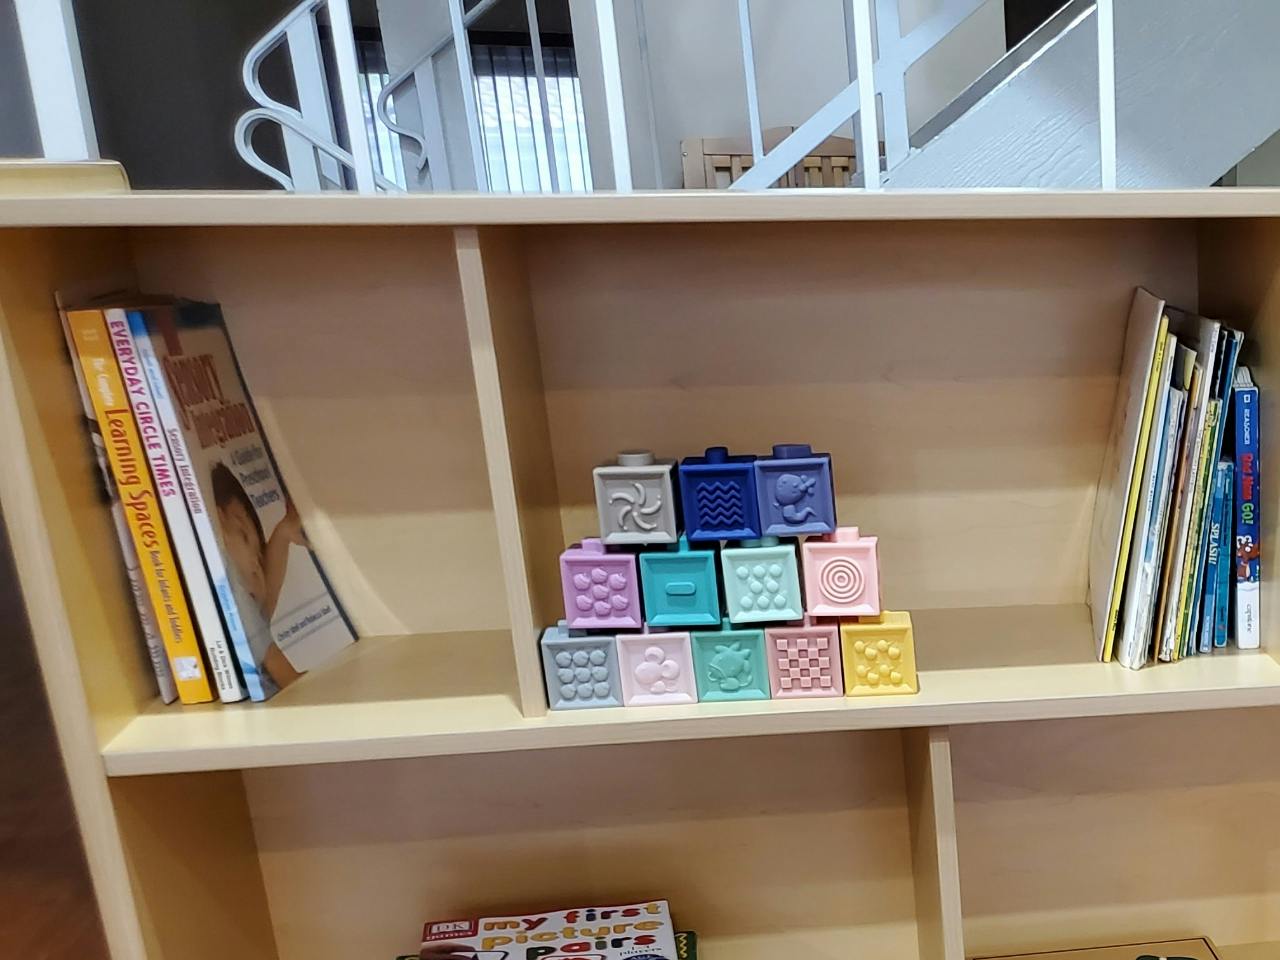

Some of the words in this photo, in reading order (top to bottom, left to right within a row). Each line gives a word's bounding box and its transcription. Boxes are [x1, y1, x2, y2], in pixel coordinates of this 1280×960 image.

[109, 319, 147, 397] EVERYDAY
[134, 400, 162, 451] CIRCLE
[152, 454, 176, 498] TIMES
[103, 407, 143, 488] Learning
[167, 427, 185, 463] Sensory
[179, 464, 202, 515] Integration
[122, 488, 160, 550] Spaces
[1241, 502, 1255, 525] GO!
[149, 549, 163, 569] Book
[1208, 522, 1220, 565] SPLASH!
[480, 918, 665, 950] picture
[482, 915, 548, 932] my
[562, 902, 663, 924] first
